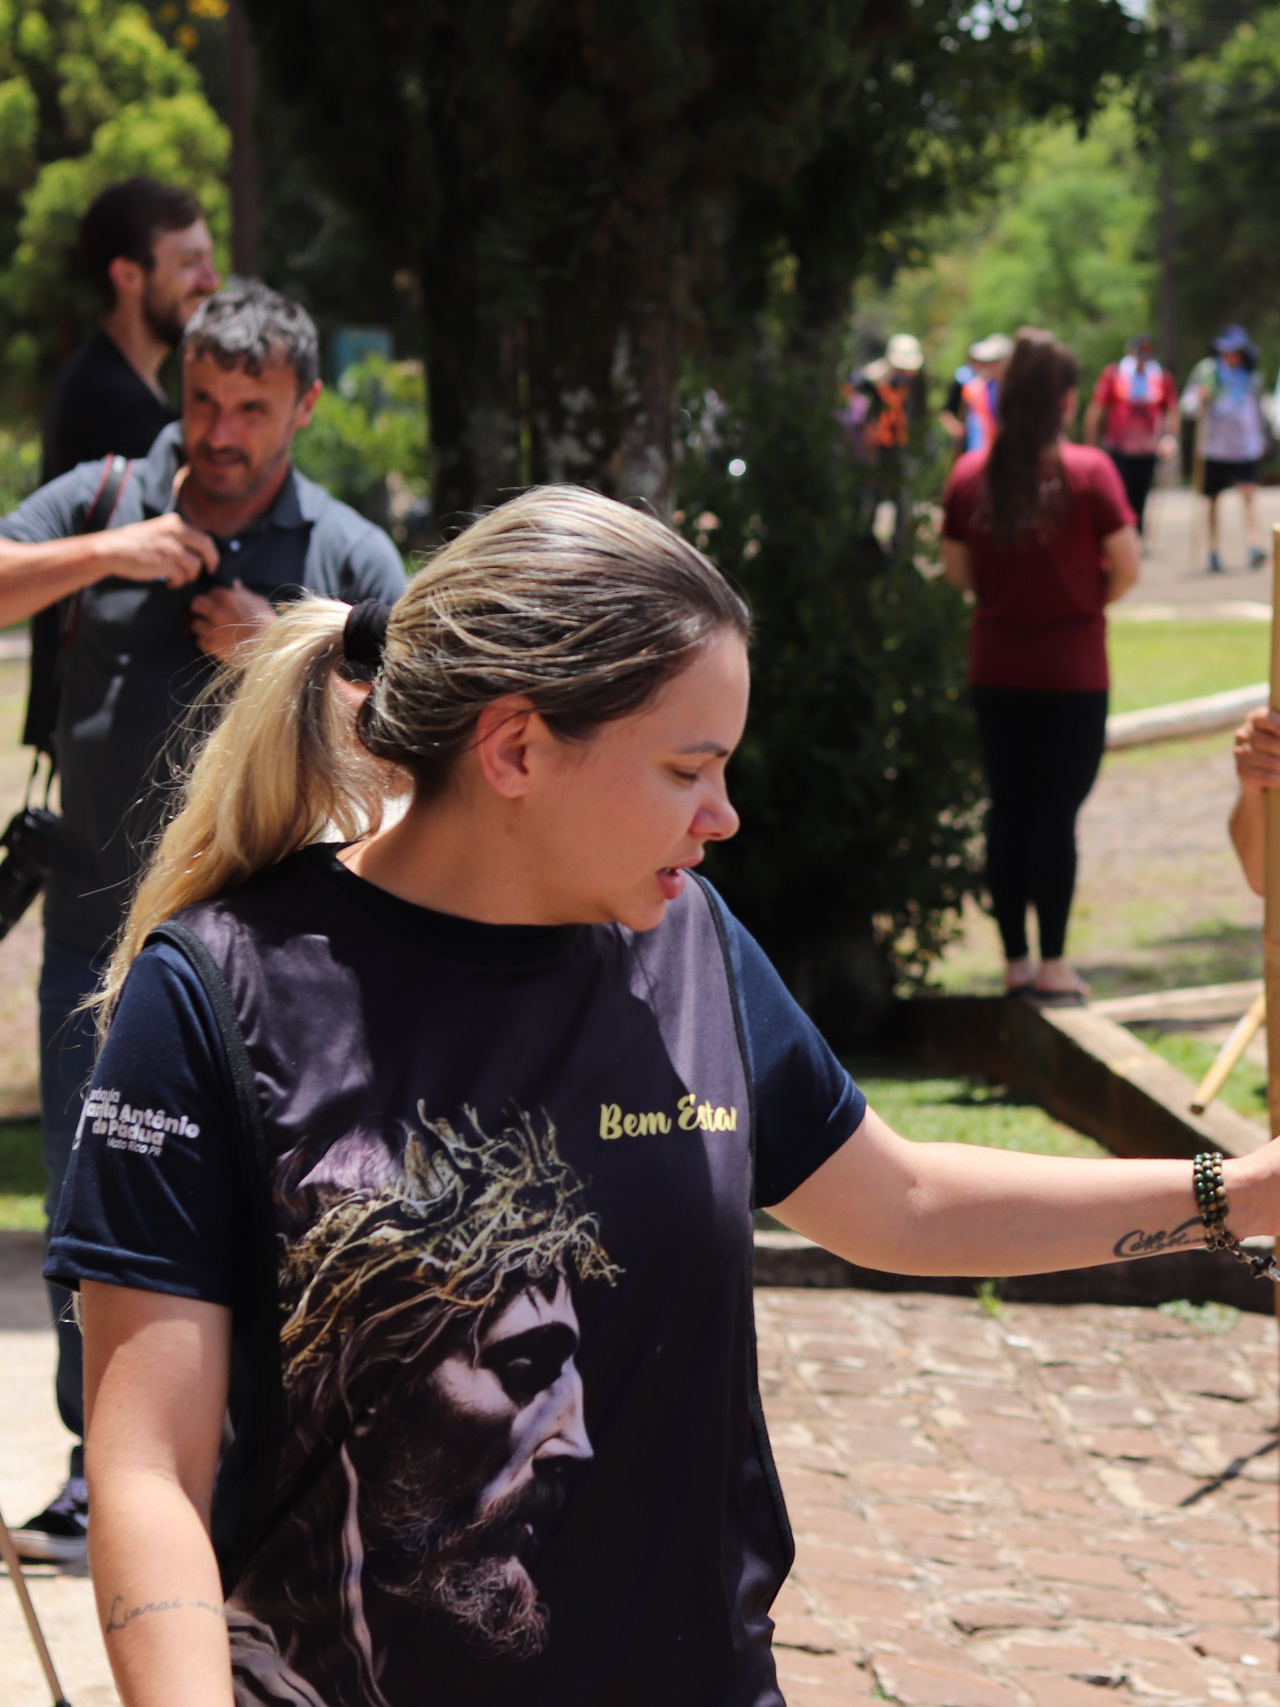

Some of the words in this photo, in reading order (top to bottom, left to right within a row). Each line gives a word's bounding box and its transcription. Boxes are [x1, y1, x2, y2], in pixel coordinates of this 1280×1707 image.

[91, 1118, 108, 1135] de
[107, 1119, 166, 1147] Pádua
[118, 1104, 201, 1139] Antônio
[599, 1103, 672, 1141] Bem
[127, 1140, 149, 1155] Rico
[147, 1145, 163, 1158] PR
